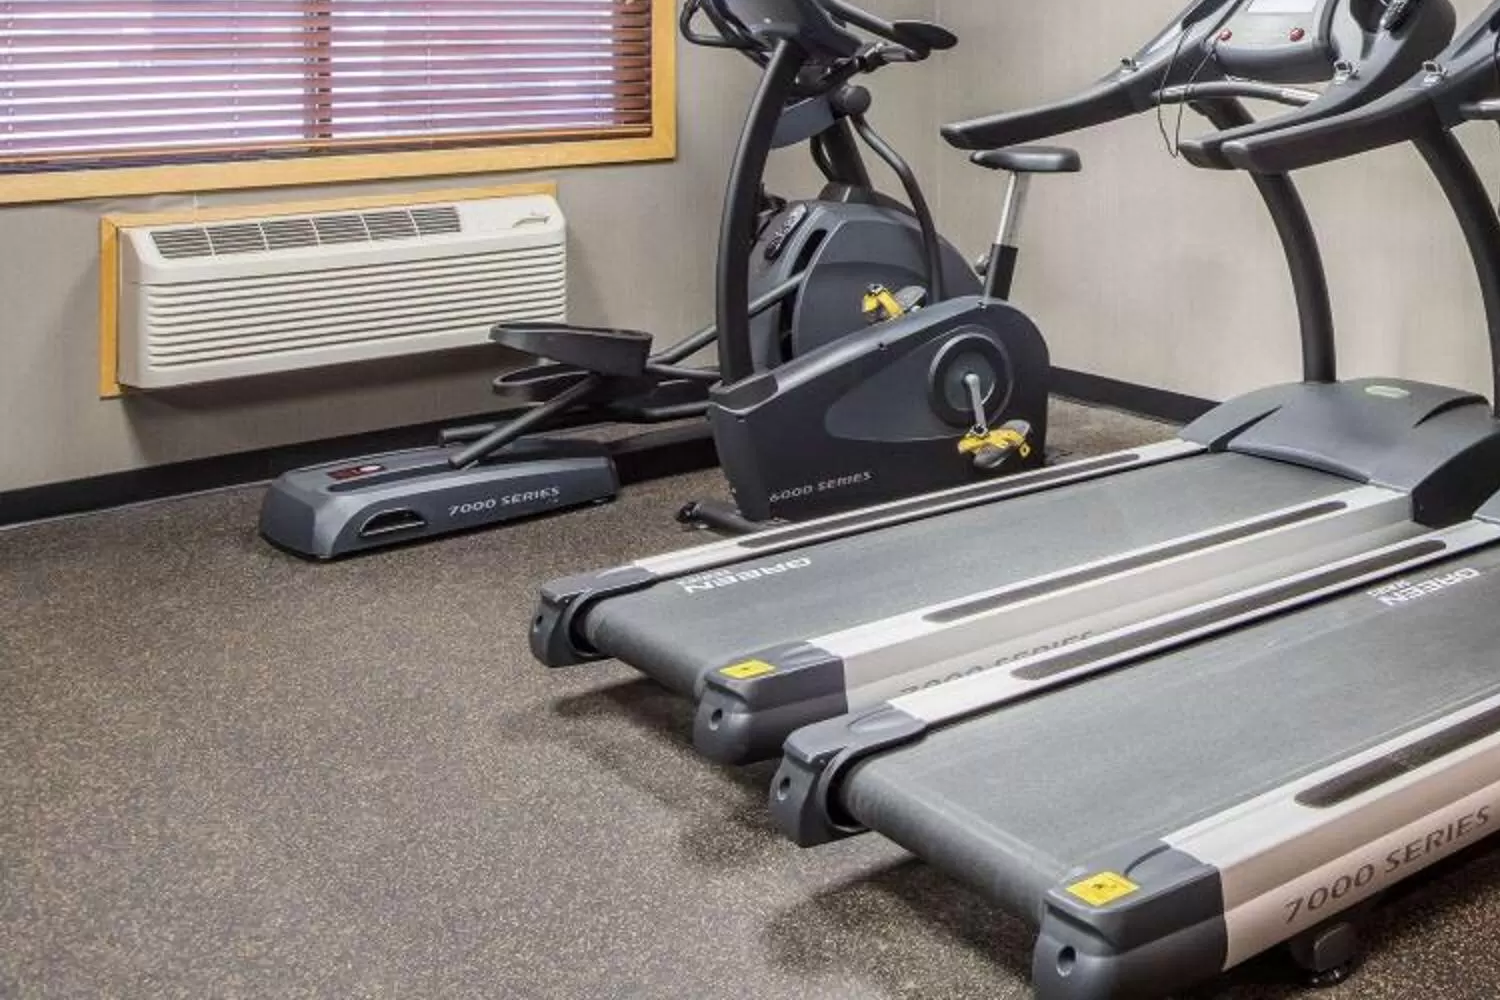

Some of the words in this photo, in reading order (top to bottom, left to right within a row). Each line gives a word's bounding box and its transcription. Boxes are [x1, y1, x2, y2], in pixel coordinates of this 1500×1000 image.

[817, 470, 873, 492] SERIES
[448, 499, 497, 517] 7000
[501, 486, 561, 506] SERIES
[1283, 863, 1375, 925] 7000
[1384, 804, 1491, 874] SERIES
